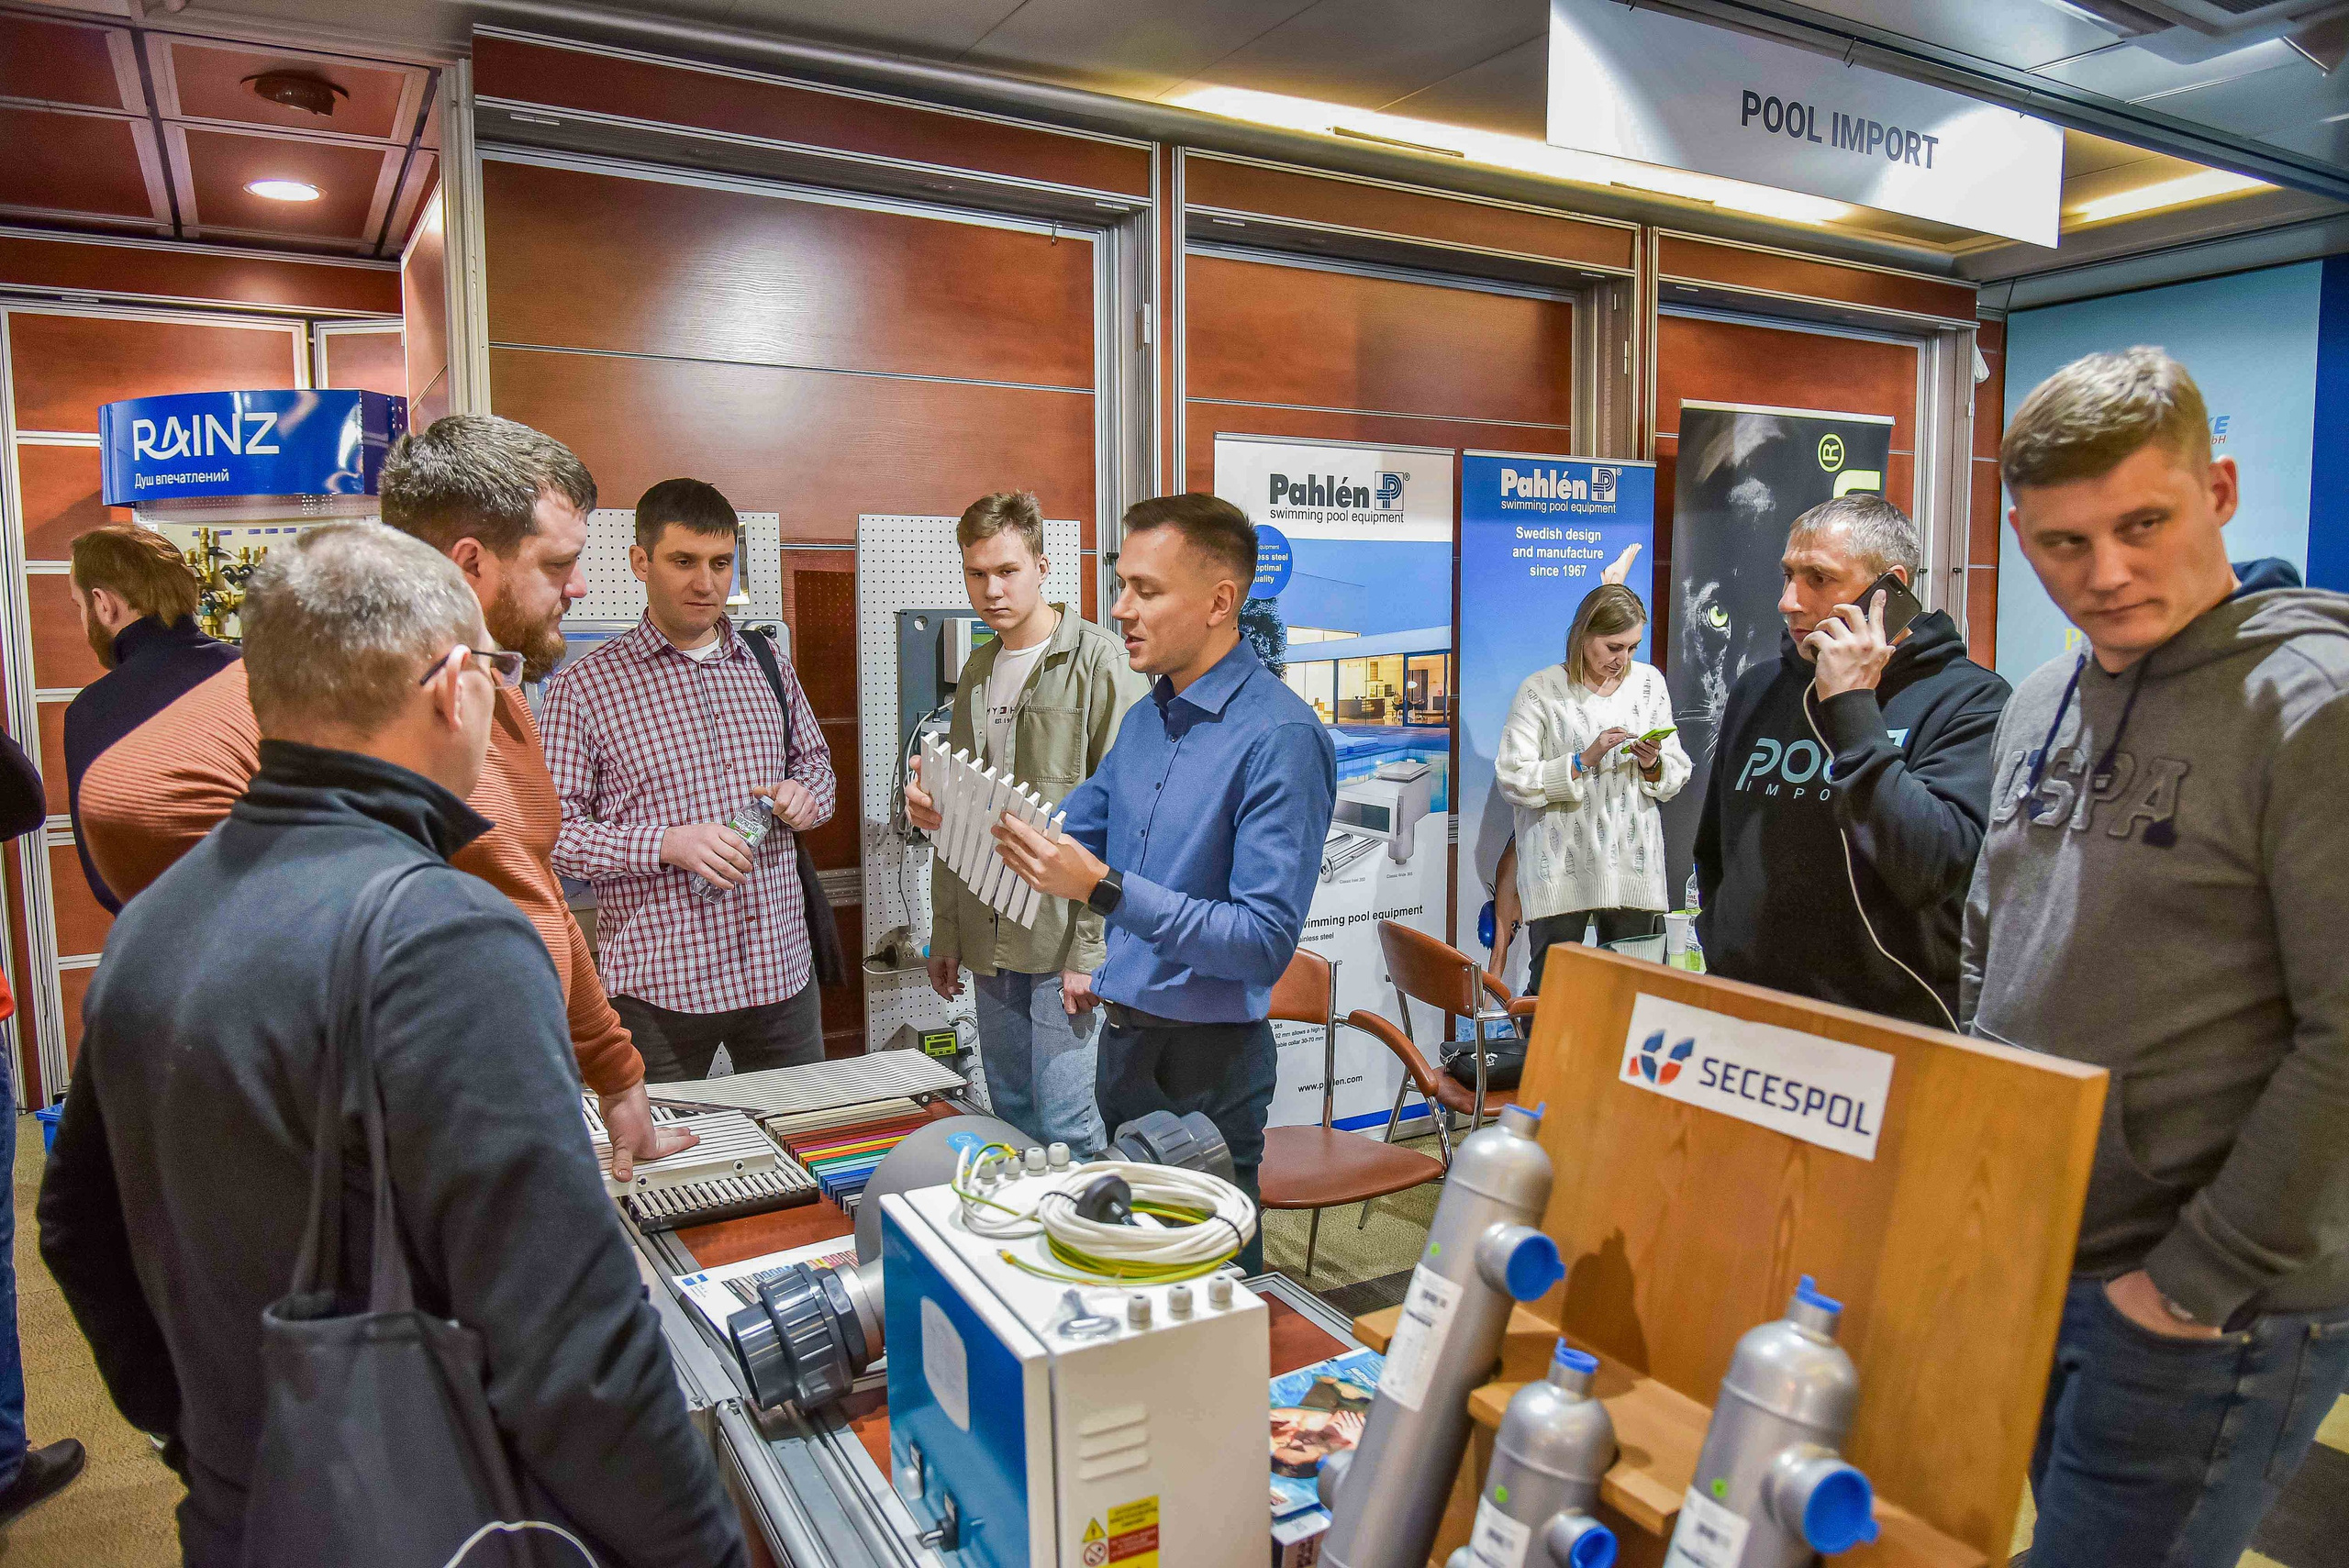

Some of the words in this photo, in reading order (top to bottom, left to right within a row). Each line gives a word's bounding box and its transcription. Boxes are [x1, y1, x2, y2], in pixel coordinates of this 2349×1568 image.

[1741, 89, 1822, 143] POOL
[1831, 111, 1939, 169] IMPORT
[2208, 416, 2231, 435] E
[132, 412, 280, 461] RAINZ
[2211, 435, 2227, 445] bH
[135, 473, 154, 489] Душ
[156, 468, 229, 485] впечатлений
[1500, 468, 1587, 500] Pahlén
[1270, 473, 1370, 508] Pahlén
[1270, 507, 1323, 523] swimming
[1326, 511, 1349, 524] pool
[1352, 512, 1405, 525] equipment
[1501, 499, 1547, 514] swimming
[1549, 501, 1569, 513] pool
[1571, 502, 1617, 515] equipment
[1516, 526, 1563, 540] Swedish
[1564, 528, 1602, 543] design
[1272, 552, 1288, 562] steel
[1512, 545, 1533, 558] and
[1536, 546, 1604, 560] manufacture
[1256, 563, 1282, 573] optimal
[1530, 564, 1559, 577] since
[1563, 564, 1587, 577] 1967
[1746, 780, 1831, 802] IMPO
[1348, 911, 1370, 926] pool
[1373, 905, 1423, 920] equipment
[1298, 935, 1319, 943] ainless
[1319, 932, 1334, 940] steel
[1297, 1074, 1364, 1092] www.plen.com
[1698, 1056, 1871, 1136] SECESPOL
